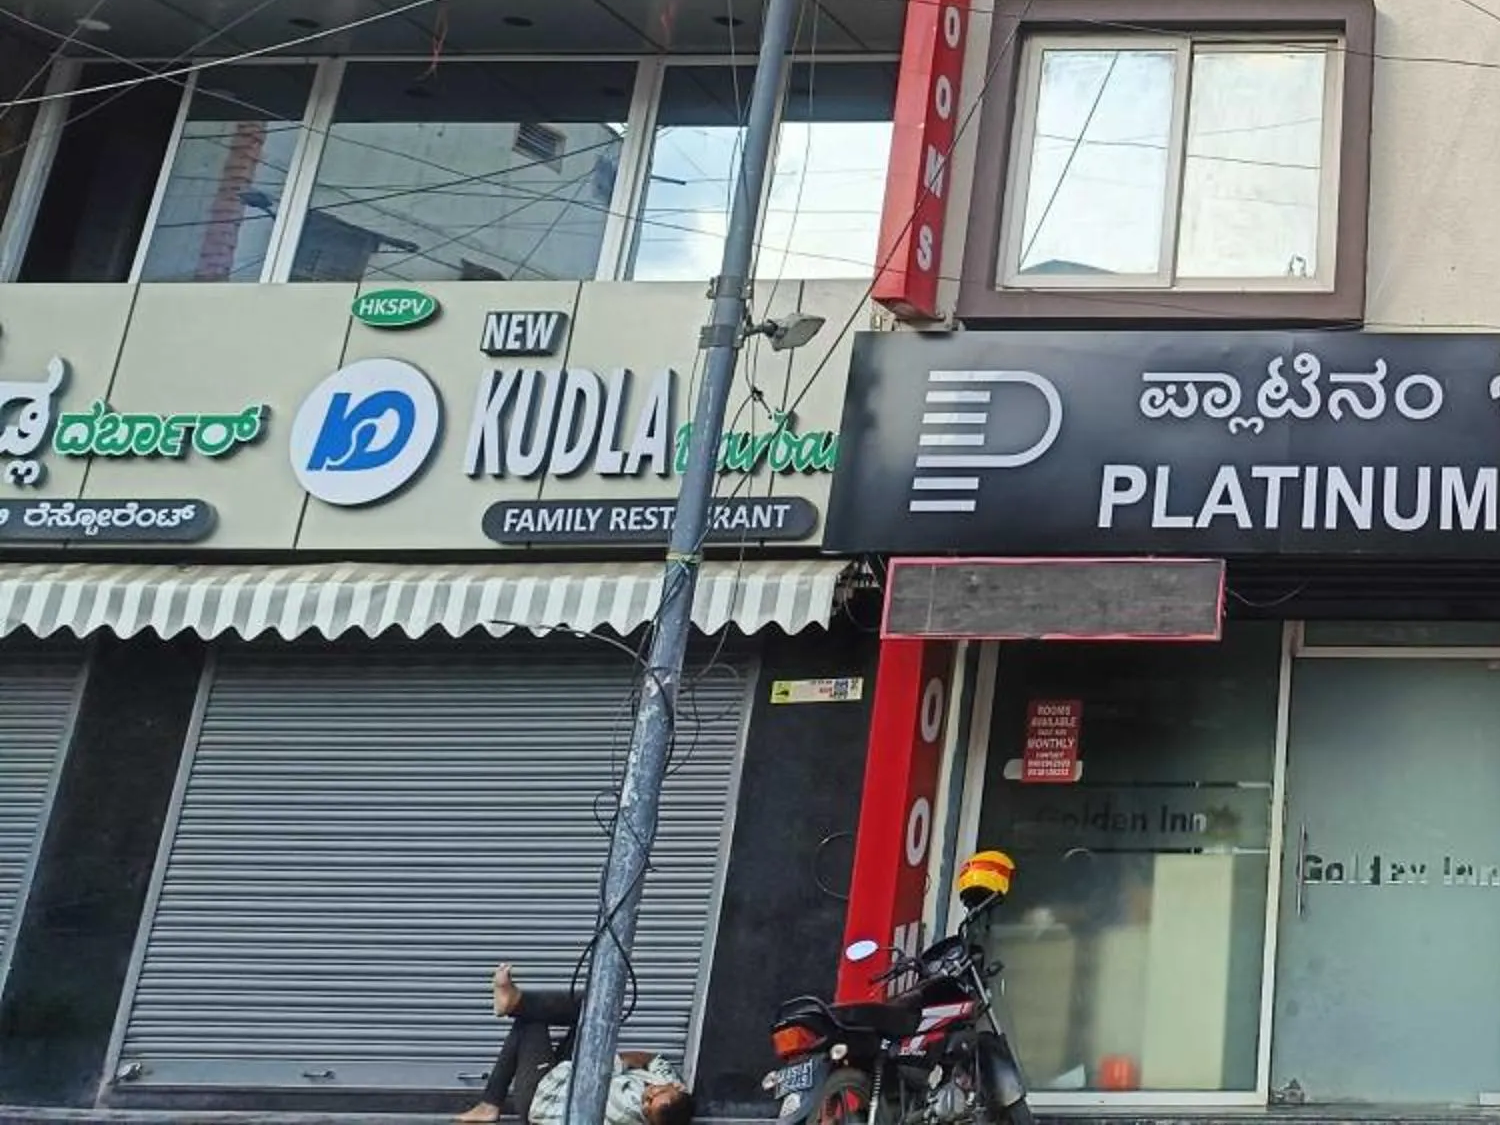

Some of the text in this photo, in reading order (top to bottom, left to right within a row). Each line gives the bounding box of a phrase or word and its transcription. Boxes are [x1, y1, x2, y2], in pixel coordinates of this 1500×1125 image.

[359, 298, 428, 315] HKSPV
[482, 313, 558, 350] NEW
[1139, 352, 1443, 435] ಪ್ಲಾಟಿನಂ
[464, 368, 672, 475] KUDLA
[503, 504, 790, 532] FAMILY RESTRANT
[1097, 465, 1498, 532] PLATINUM
